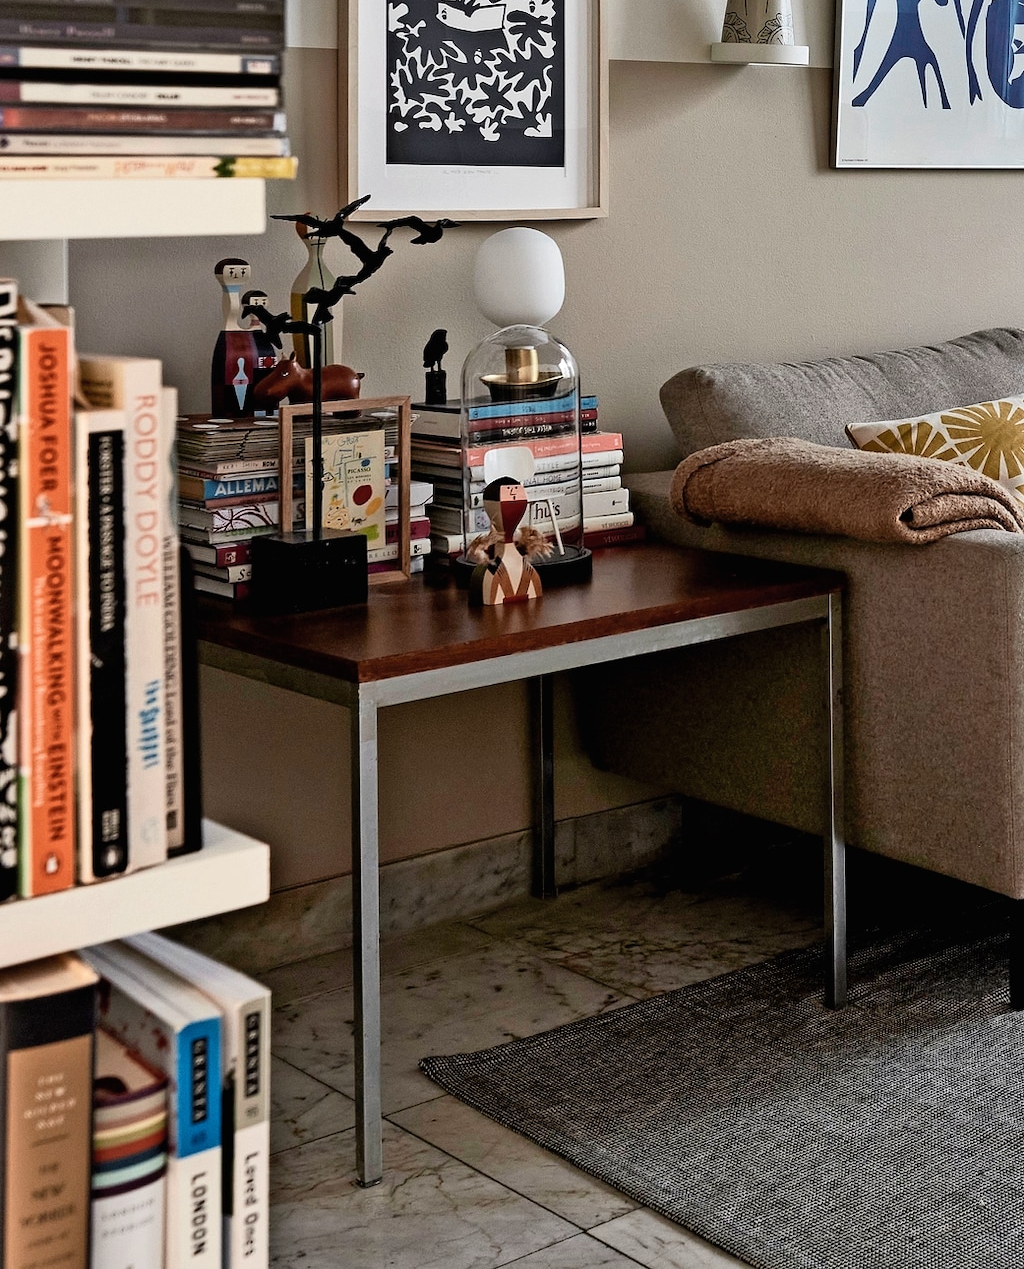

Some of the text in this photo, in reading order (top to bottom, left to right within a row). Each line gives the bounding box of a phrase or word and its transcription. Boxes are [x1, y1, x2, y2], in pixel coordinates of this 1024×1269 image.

[37, 342, 60, 492] JOSHUA FOER
[134, 395, 159, 607] RODDY DOYLE
[46, 535, 67, 705] MOONWALKING
[47, 743, 68, 841] EINSTEIN
[191, 1172, 207, 1257] LONDON
[245, 1152, 259, 1206] Loved
